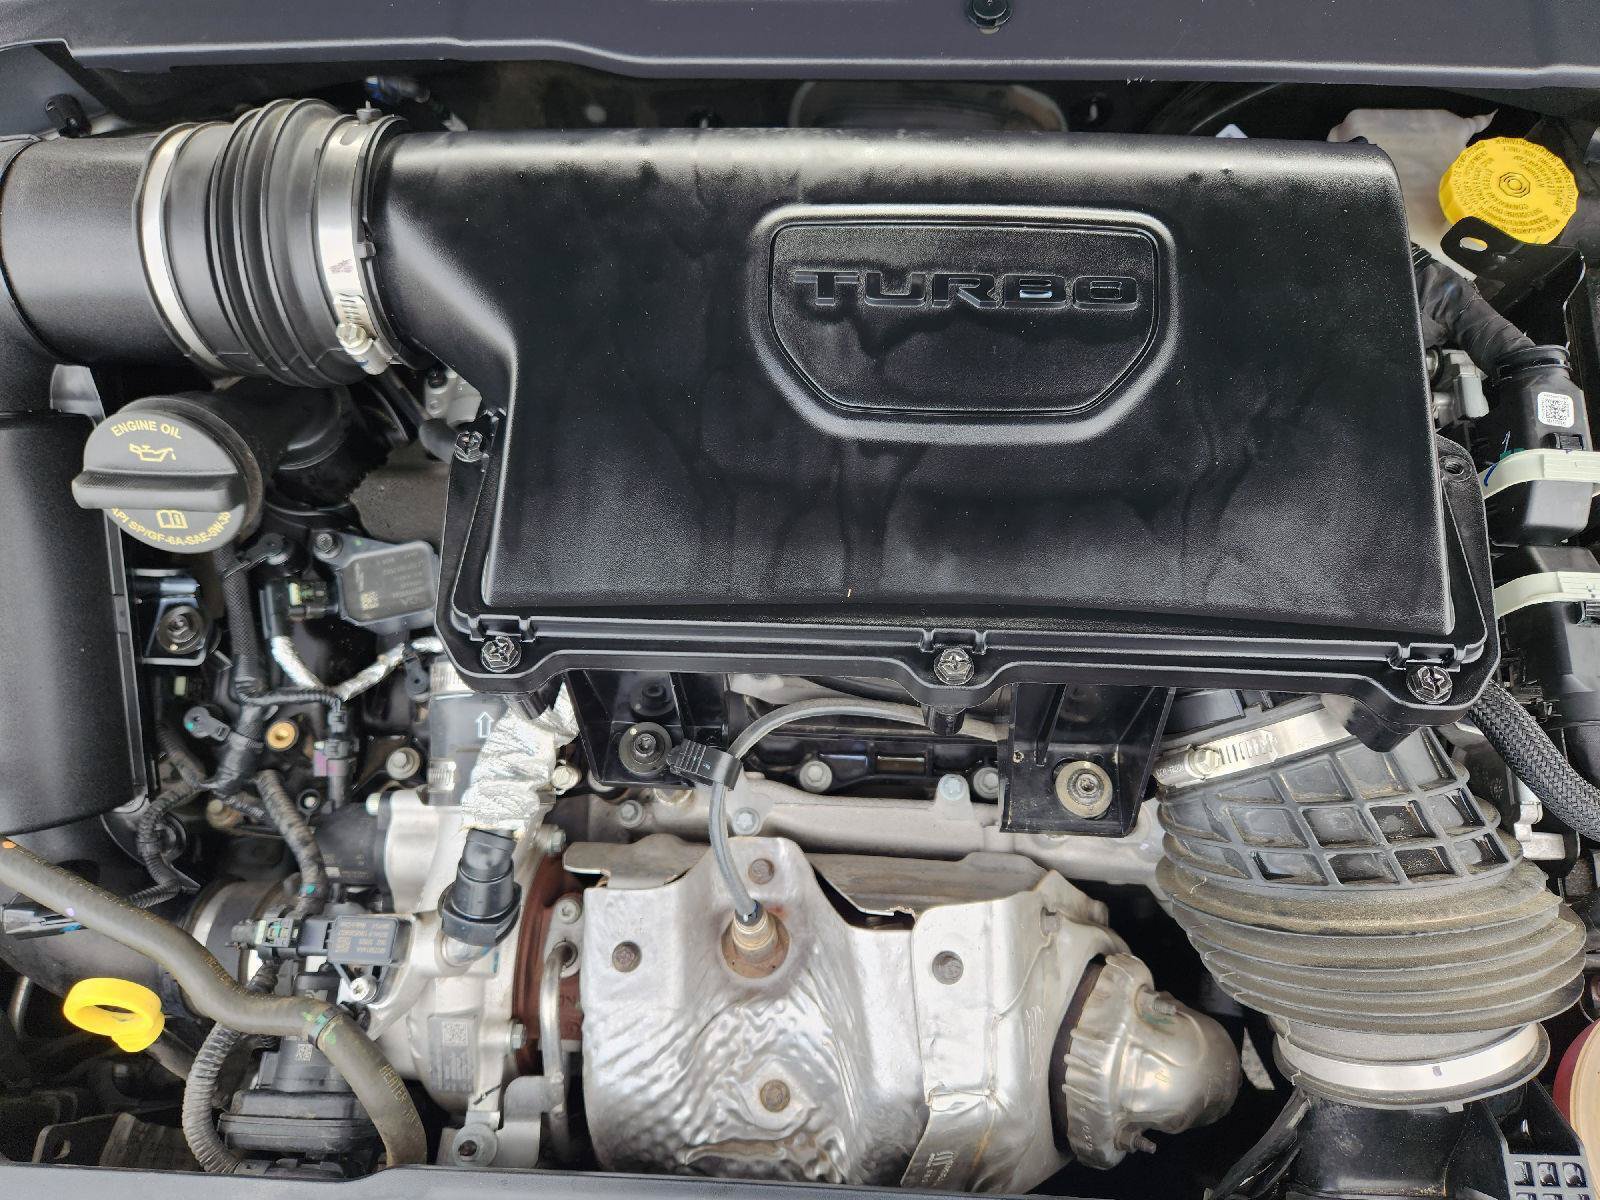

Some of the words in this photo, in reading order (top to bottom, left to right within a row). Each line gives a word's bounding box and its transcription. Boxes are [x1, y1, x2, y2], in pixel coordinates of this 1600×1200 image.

[794, 270, 1139, 311] TURBO
[111, 420, 158, 438] ENGINE
[160, 423, 183, 440] OIL
